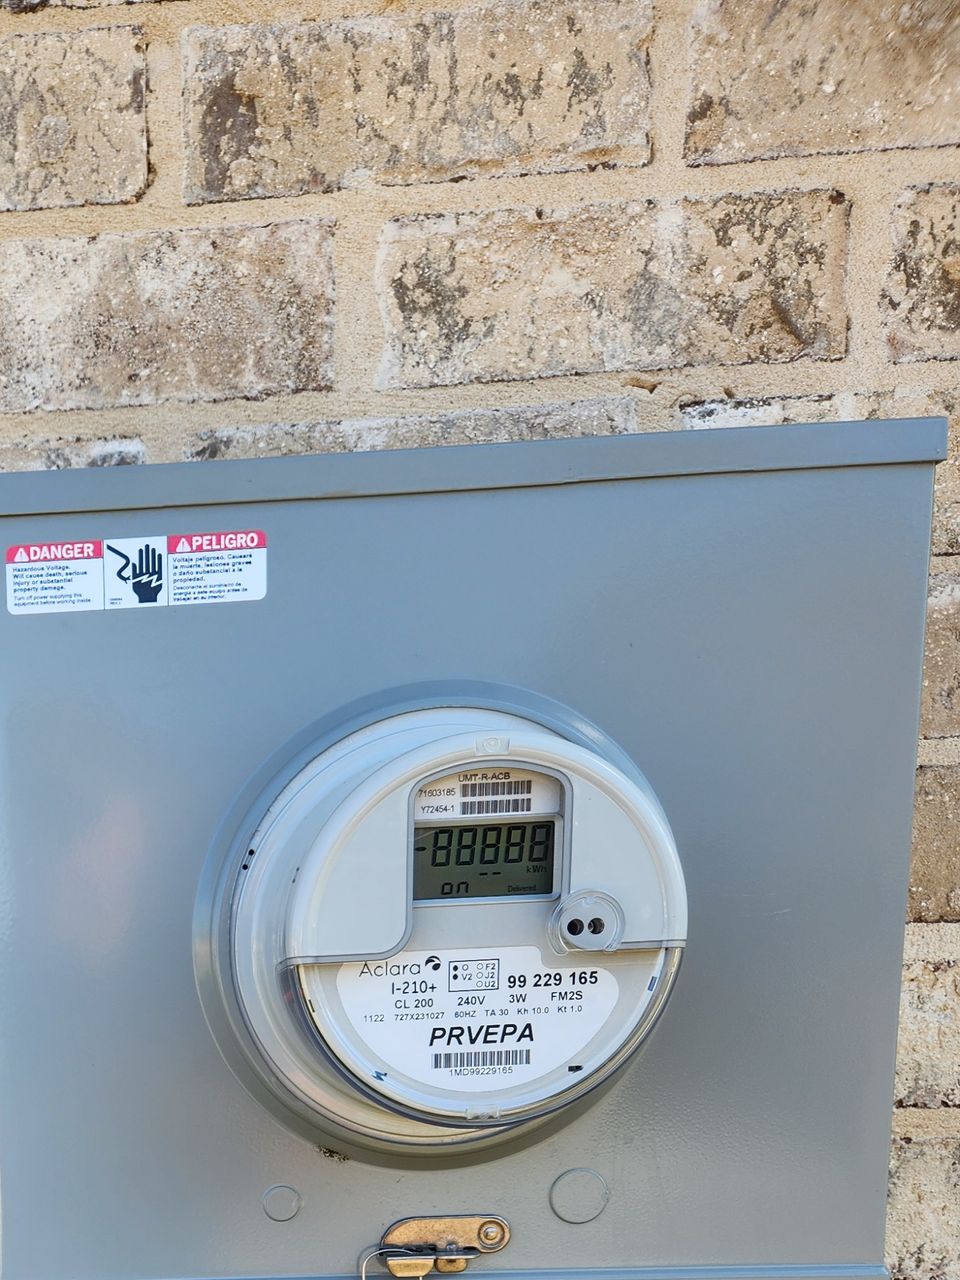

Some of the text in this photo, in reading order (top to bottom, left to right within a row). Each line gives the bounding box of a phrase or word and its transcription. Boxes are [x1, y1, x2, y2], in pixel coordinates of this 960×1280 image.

[192, 533, 258, 550] PELIGRO
[30, 543, 94, 560] DANGER
[458, 772, 510, 782] UMT-R-ACB
[421, 805, 455, 813] Y72454-1
[359, 961, 421, 977] Aclara
[392, 980, 437, 995] I-210+
[508, 971, 598, 988] 99 229 165
[395, 991, 583, 1009] CL 200 240V 3W FM2S
[395, 1012, 444, 1021] 727X231027
[429, 1023, 534, 1047] PRVEPA
[449, 1066, 514, 1077] 1MD99229165
